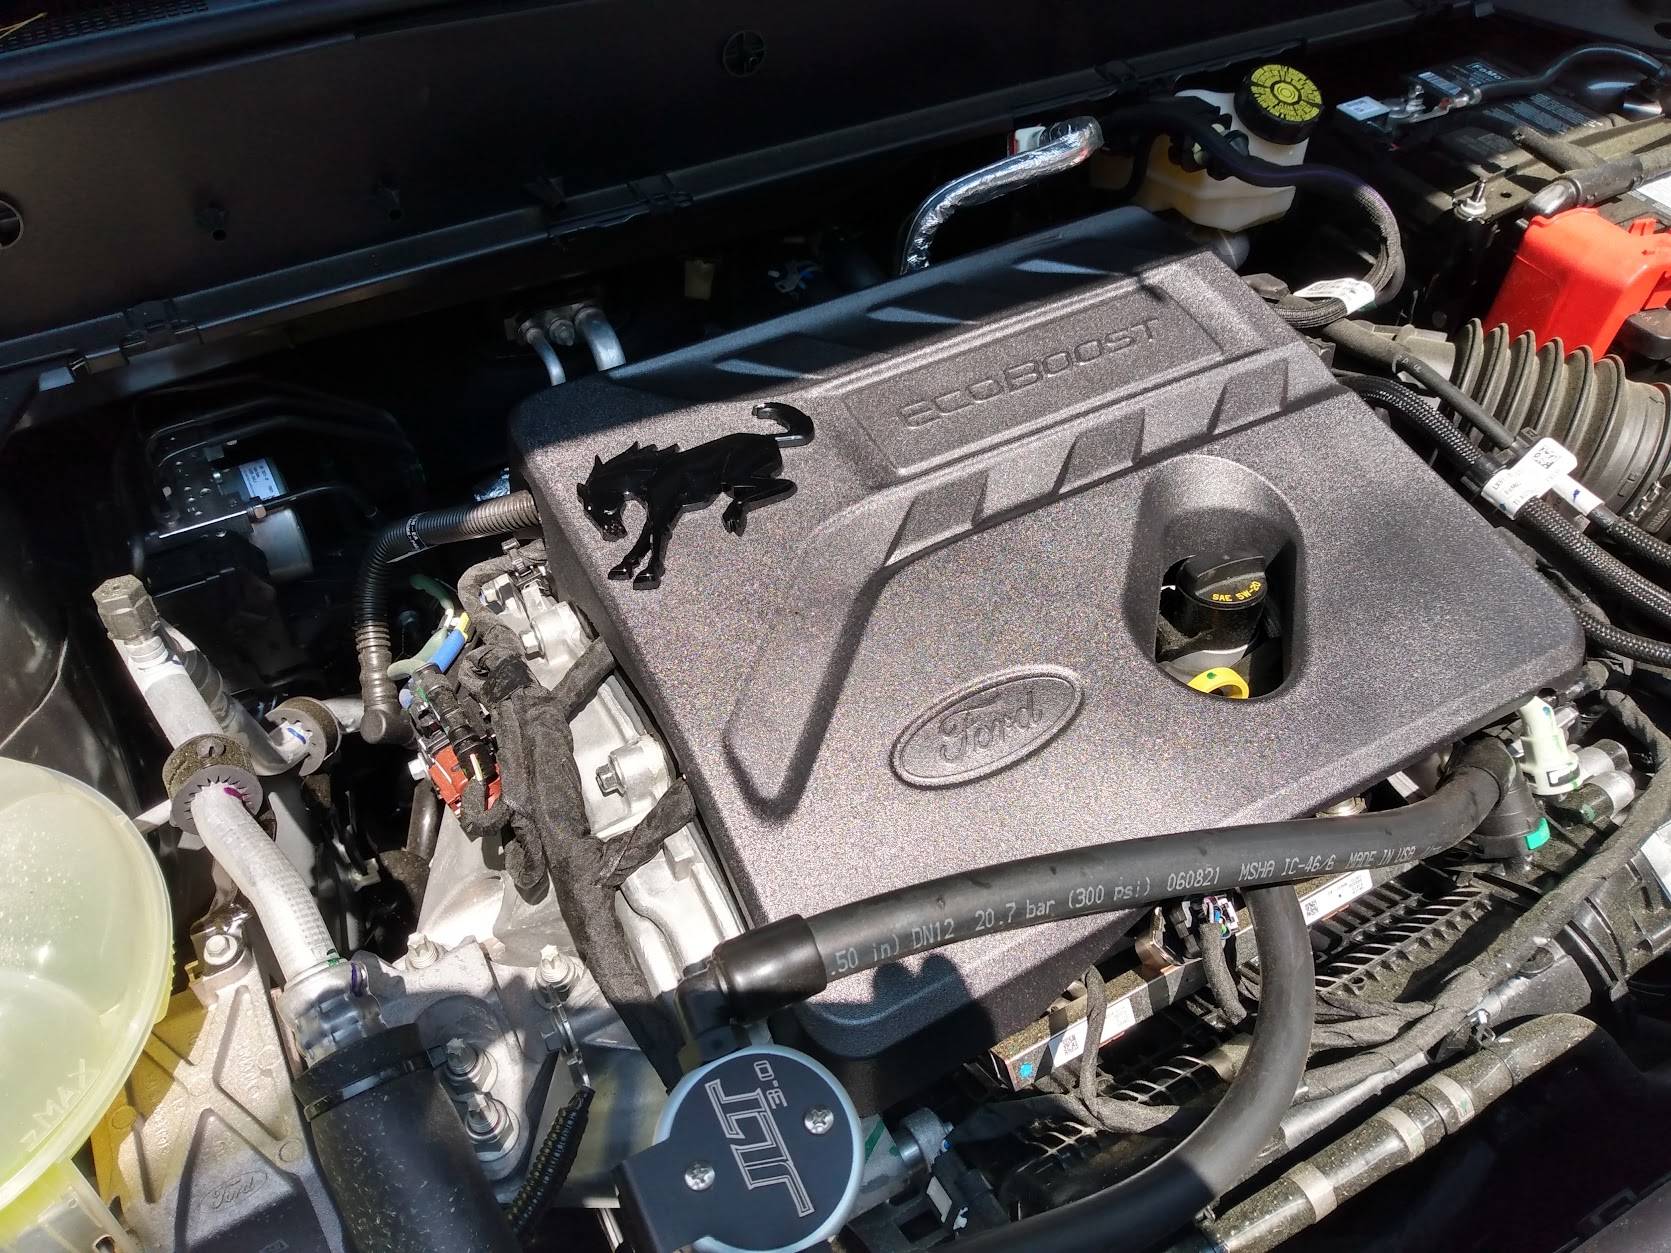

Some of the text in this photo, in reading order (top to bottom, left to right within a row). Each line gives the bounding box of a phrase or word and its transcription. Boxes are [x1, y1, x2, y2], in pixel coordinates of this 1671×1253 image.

[900, 317, 1158, 428] ECOBOOST
[1211, 593, 1232, 602] SAE
[938, 689, 1043, 764] Ford
[872, 933, 900, 962] in)
[911, 918, 955, 950] DN12
[975, 902, 1016, 932] 20.7
[1026, 898, 1055, 918] bar
[1069, 884, 1105, 909] (300
[1113, 876, 1150, 902] psi)
[1167, 866, 1220, 892] 060821
[1238, 859, 1276, 882] MSHA
[1281, 853, 1336, 876] IC-46/6
[1346, 849, 1377, 868] MADE
[1378, 848, 1395, 866] IN
[208, 1174, 256, 1210] Ford
